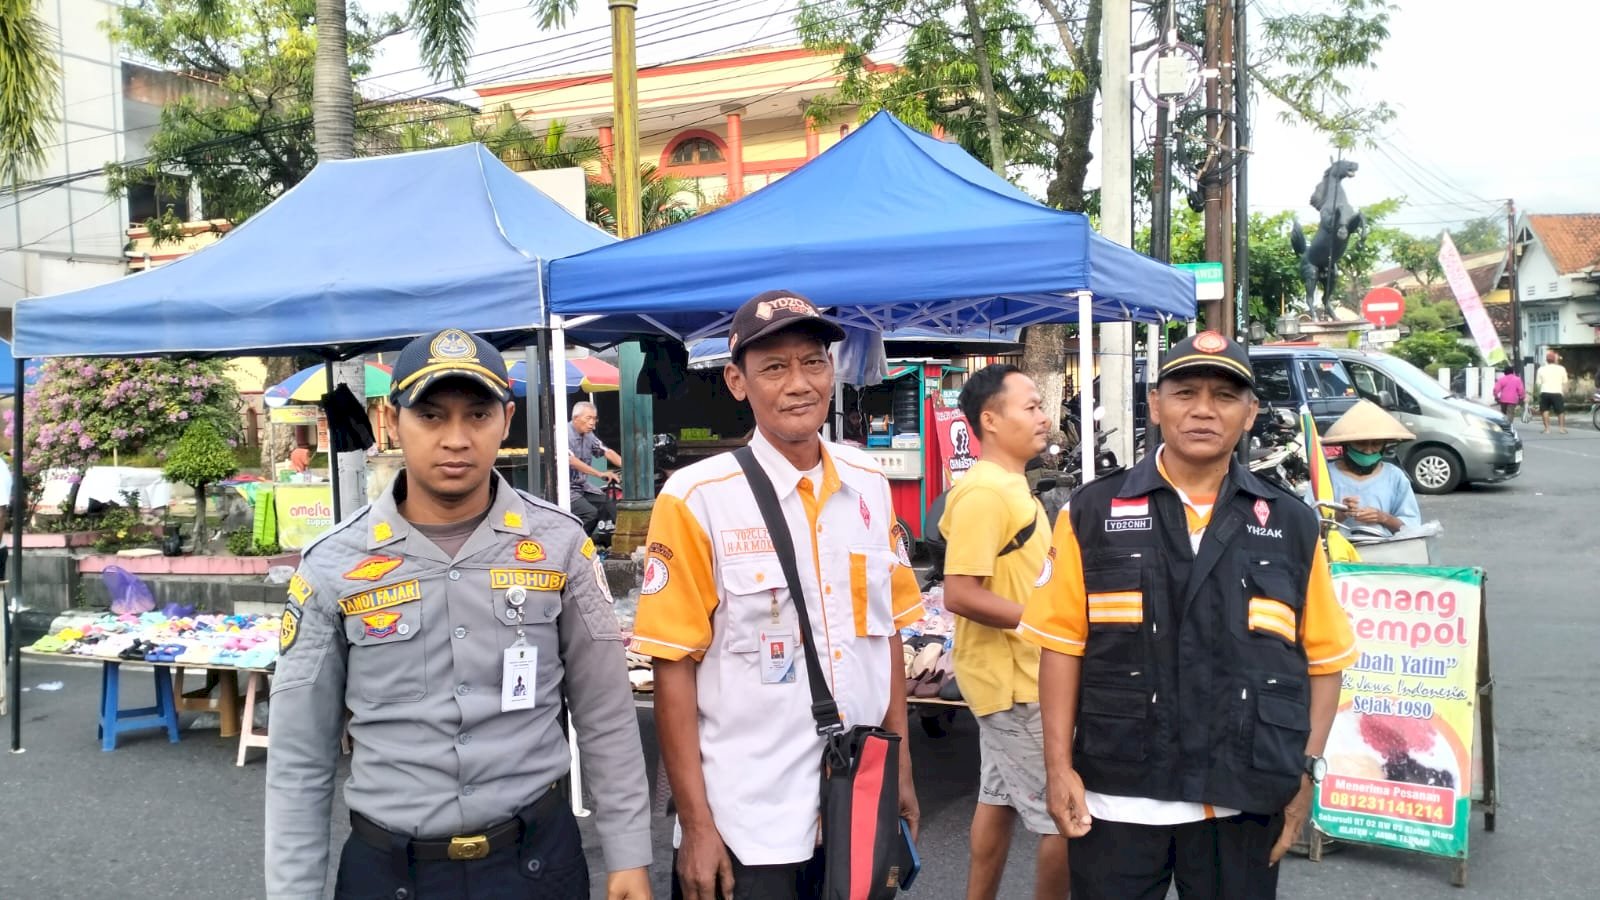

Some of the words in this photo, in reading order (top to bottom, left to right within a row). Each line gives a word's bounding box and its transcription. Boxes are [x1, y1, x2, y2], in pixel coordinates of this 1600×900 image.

[290, 501, 331, 517] amelia
[1246, 524, 1283, 538] YH2AK
[727, 540, 776, 553] HARMOK
[495, 572, 561, 588] DISHUB
[377, 584, 415, 605] FAJAR
[1340, 581, 1456, 618] Jenang
[1348, 611, 1467, 648] empol
[1354, 652, 1394, 672] bah
[1356, 675, 1392, 691] Jawa
[1398, 679, 1467, 699] Indonesia
[1353, 696, 1393, 714] Sejak
[1397, 701, 1432, 717] 1980
[1335, 779, 1390, 796] Menerima
[1393, 786, 1441, 803] Pesanan
[1330, 792, 1444, 820] 081231141214
